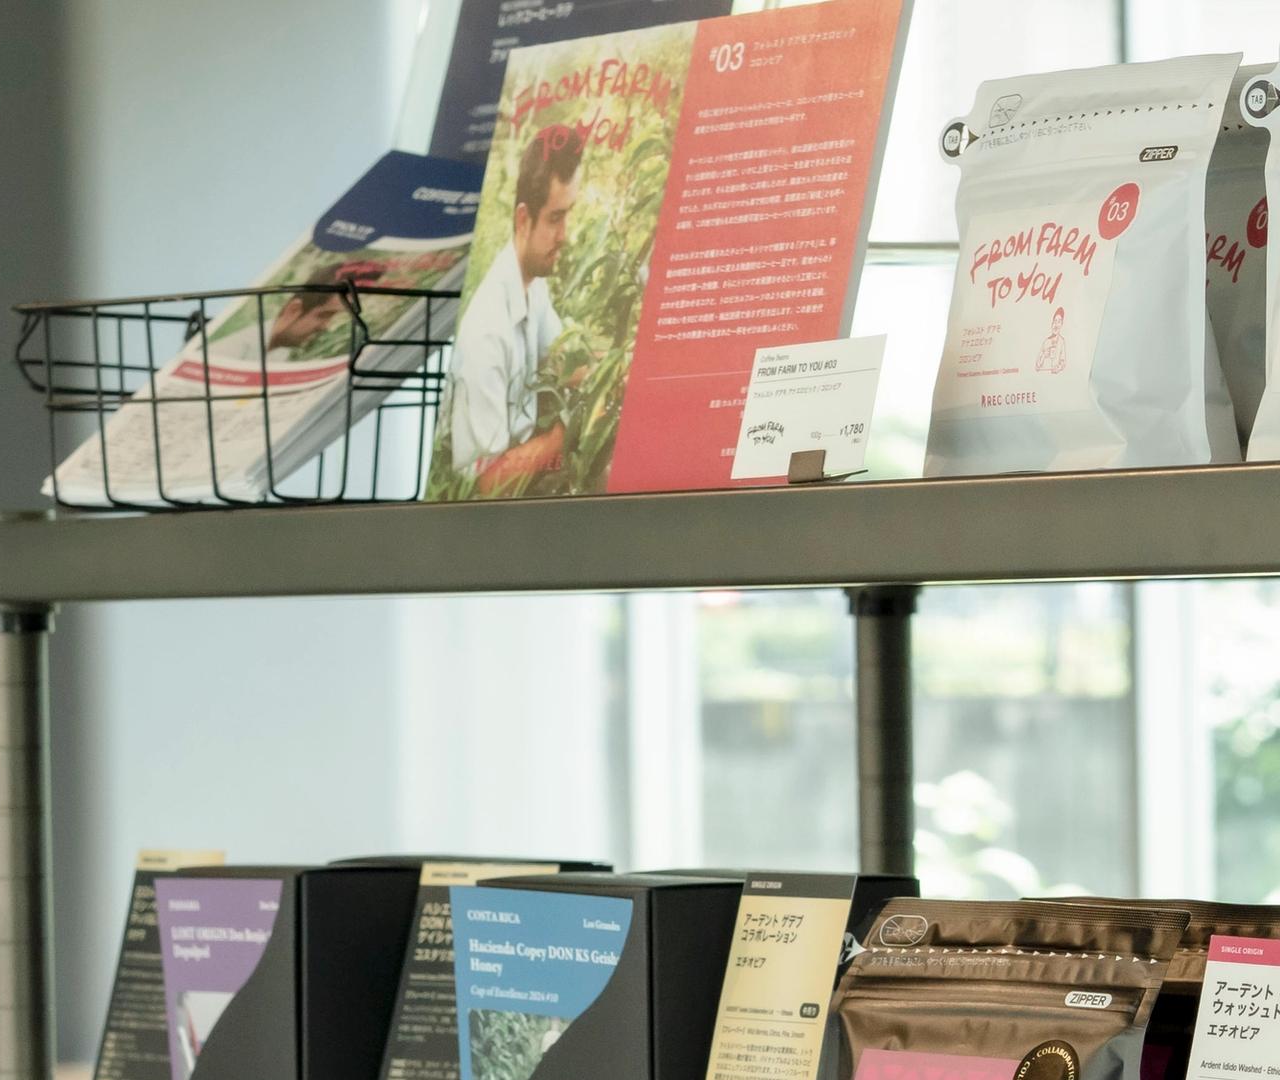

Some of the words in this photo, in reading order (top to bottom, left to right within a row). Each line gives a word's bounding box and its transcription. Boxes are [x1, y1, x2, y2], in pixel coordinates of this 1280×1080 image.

[709, 41, 745, 72] #03
[511, 63, 592, 131] FROM
[597, 58, 672, 117] FARM
[1251, 93, 1264, 105] TAB
[534, 124, 571, 161] TO
[572, 106, 634, 154] YOU
[1142, 148, 1175, 161] ZIPPER
[970, 227, 1034, 284] FROM
[1036, 222, 1097, 276] FARM
[987, 277, 1013, 309] TO
[1016, 263, 1063, 304] YOU
[757, 365, 777, 377] FROM
[778, 364, 797, 375] FARM
[798, 363, 808, 373] TO
[809, 361, 823, 372] YOU
[824, 360, 837, 370] #03
[987, 395, 1002, 407] REC
[1005, 392, 1037, 405] COFFEE
[767, 421, 784, 436] FARM
[467, 910, 497, 922] COSTA
[498, 912, 521, 924] RICA
[744, 914, 778, 927] アーデント
[741, 929, 798, 943] コラボレーション
[469, 939, 515, 956] Hacienda
[517, 943, 546, 962] Copey
[548, 945, 573, 961] DON
[575, 948, 589, 963] KS
[1221, 946, 1241, 954] SINGLE
[1242, 948, 1264, 956] ORIGIN
[470, 958, 503, 977] Honey
[736, 957, 766, 968] エチオピア
[1215, 981, 1274, 1001] アーデント
[1069, 993, 1107, 1006] ZIPPER
[1207, 1024, 1260, 1040] エチオピア
[1200, 1060, 1221, 1069] Ardent
[1222, 1062, 1237, 1072] Idido
[1238, 1063, 1262, 1074] Washed
